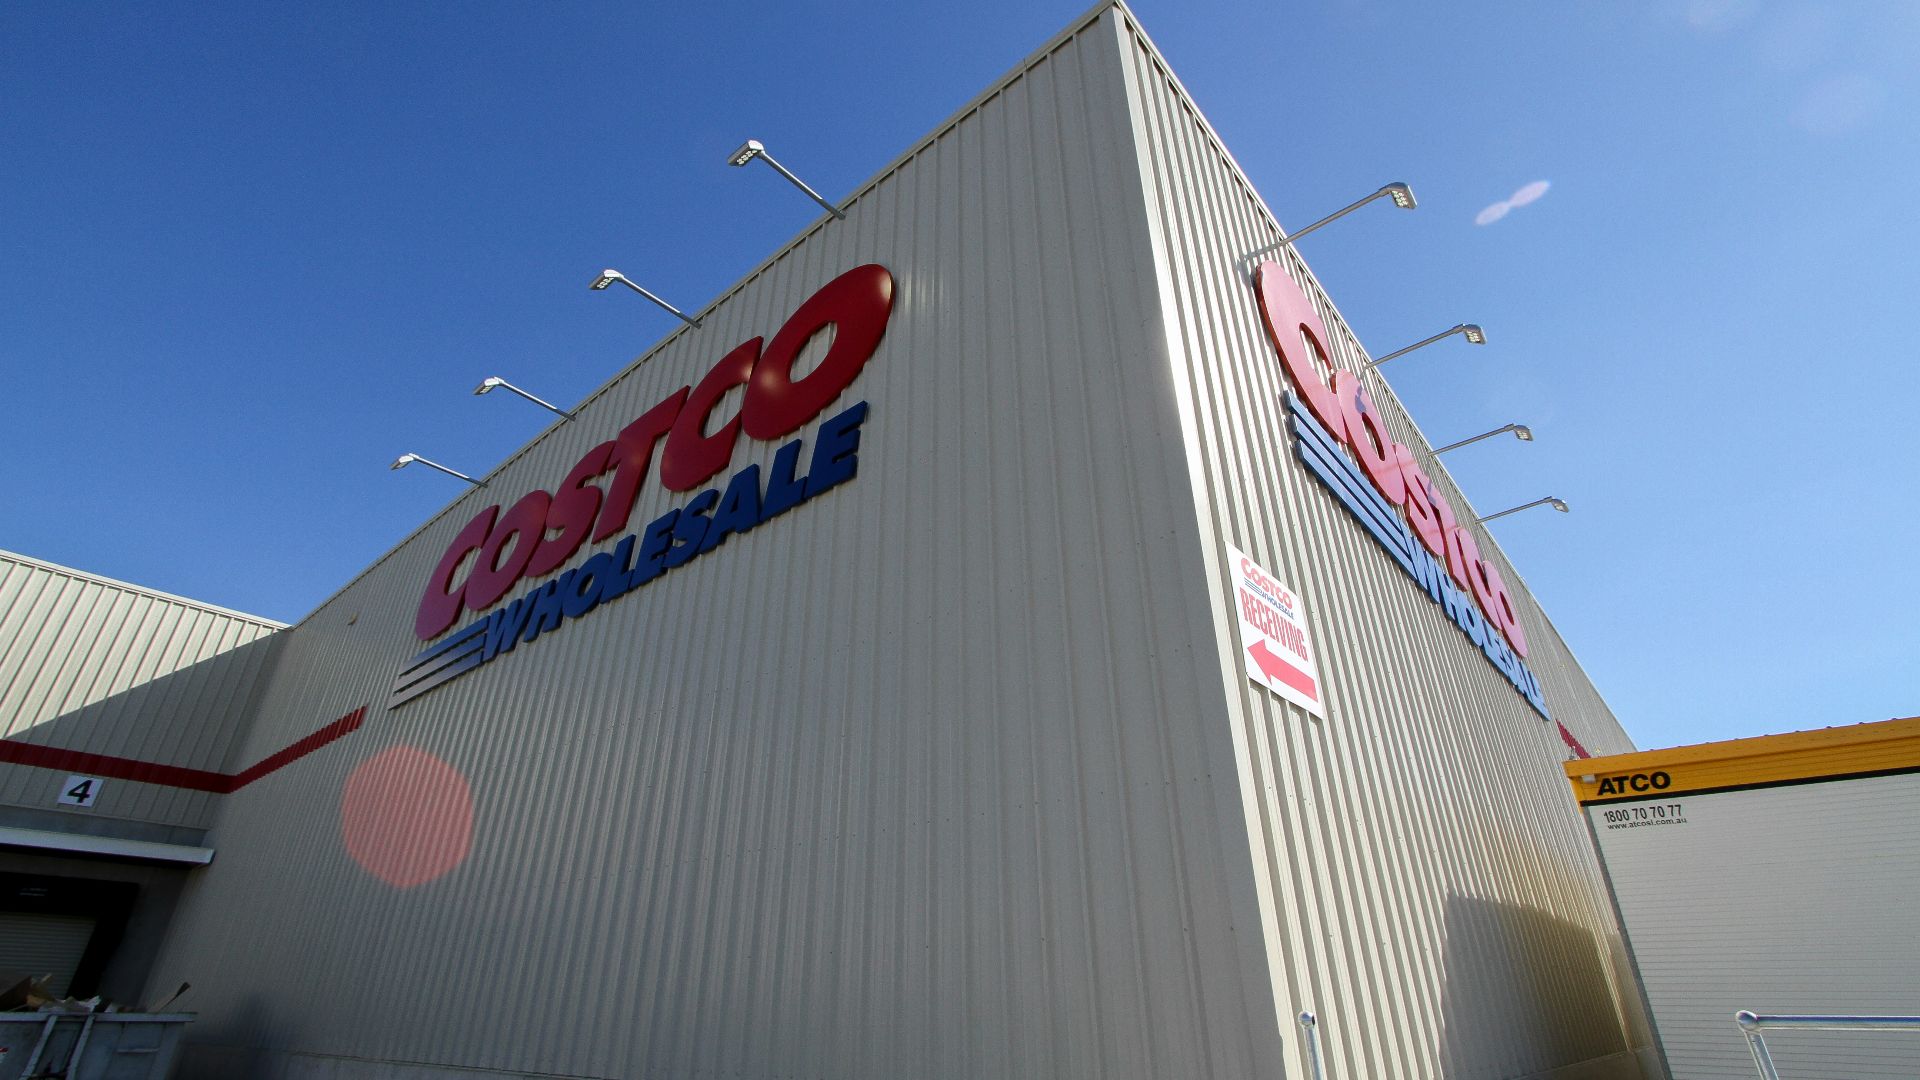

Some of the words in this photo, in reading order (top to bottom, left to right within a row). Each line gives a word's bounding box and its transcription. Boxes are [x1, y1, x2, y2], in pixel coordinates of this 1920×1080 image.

[415, 263, 894, 641] COSTCO
[1256, 260, 1529, 658] COSTCO
[483, 400, 868, 662] WHOLESALE
[1241, 558, 1293, 609] COSTCO
[1260, 590, 1295, 620] WHOLESALE
[1240, 587, 1308, 662] RECEIVING
[68, 780, 93, 804] 4
[1597, 771, 1671, 796] ATCO
[1604, 809, 1630, 823] 1800
[1632, 808, 1647, 820] 70
[1649, 806, 1665, 818] 70
[1667, 804, 1682, 816] 77
